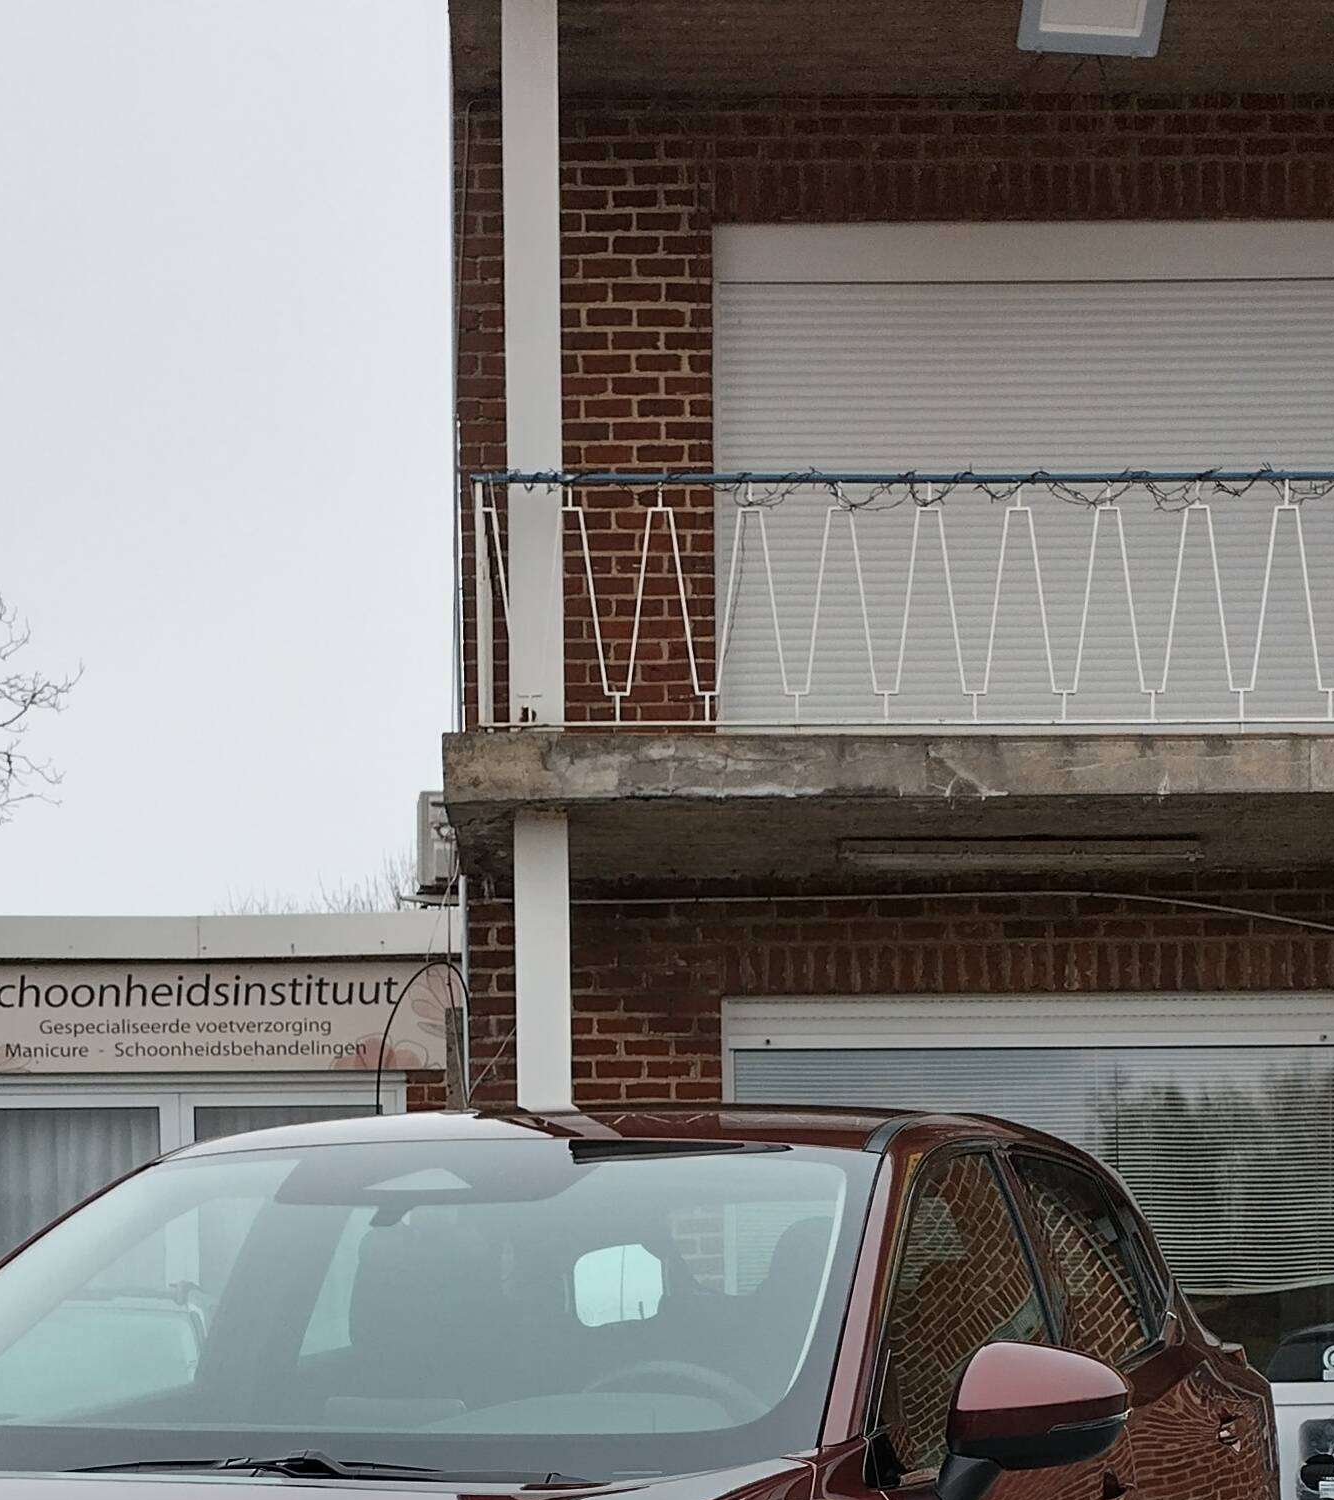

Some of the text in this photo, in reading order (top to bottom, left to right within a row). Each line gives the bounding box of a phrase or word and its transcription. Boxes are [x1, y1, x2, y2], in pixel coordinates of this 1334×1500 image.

[39, 1017, 332, 1038] Gespecialiseerde voetverzorging
[5, 1041, 90, 1059] Manicure
[114, 1039, 368, 1059] Schoonheidsbehandelingen
